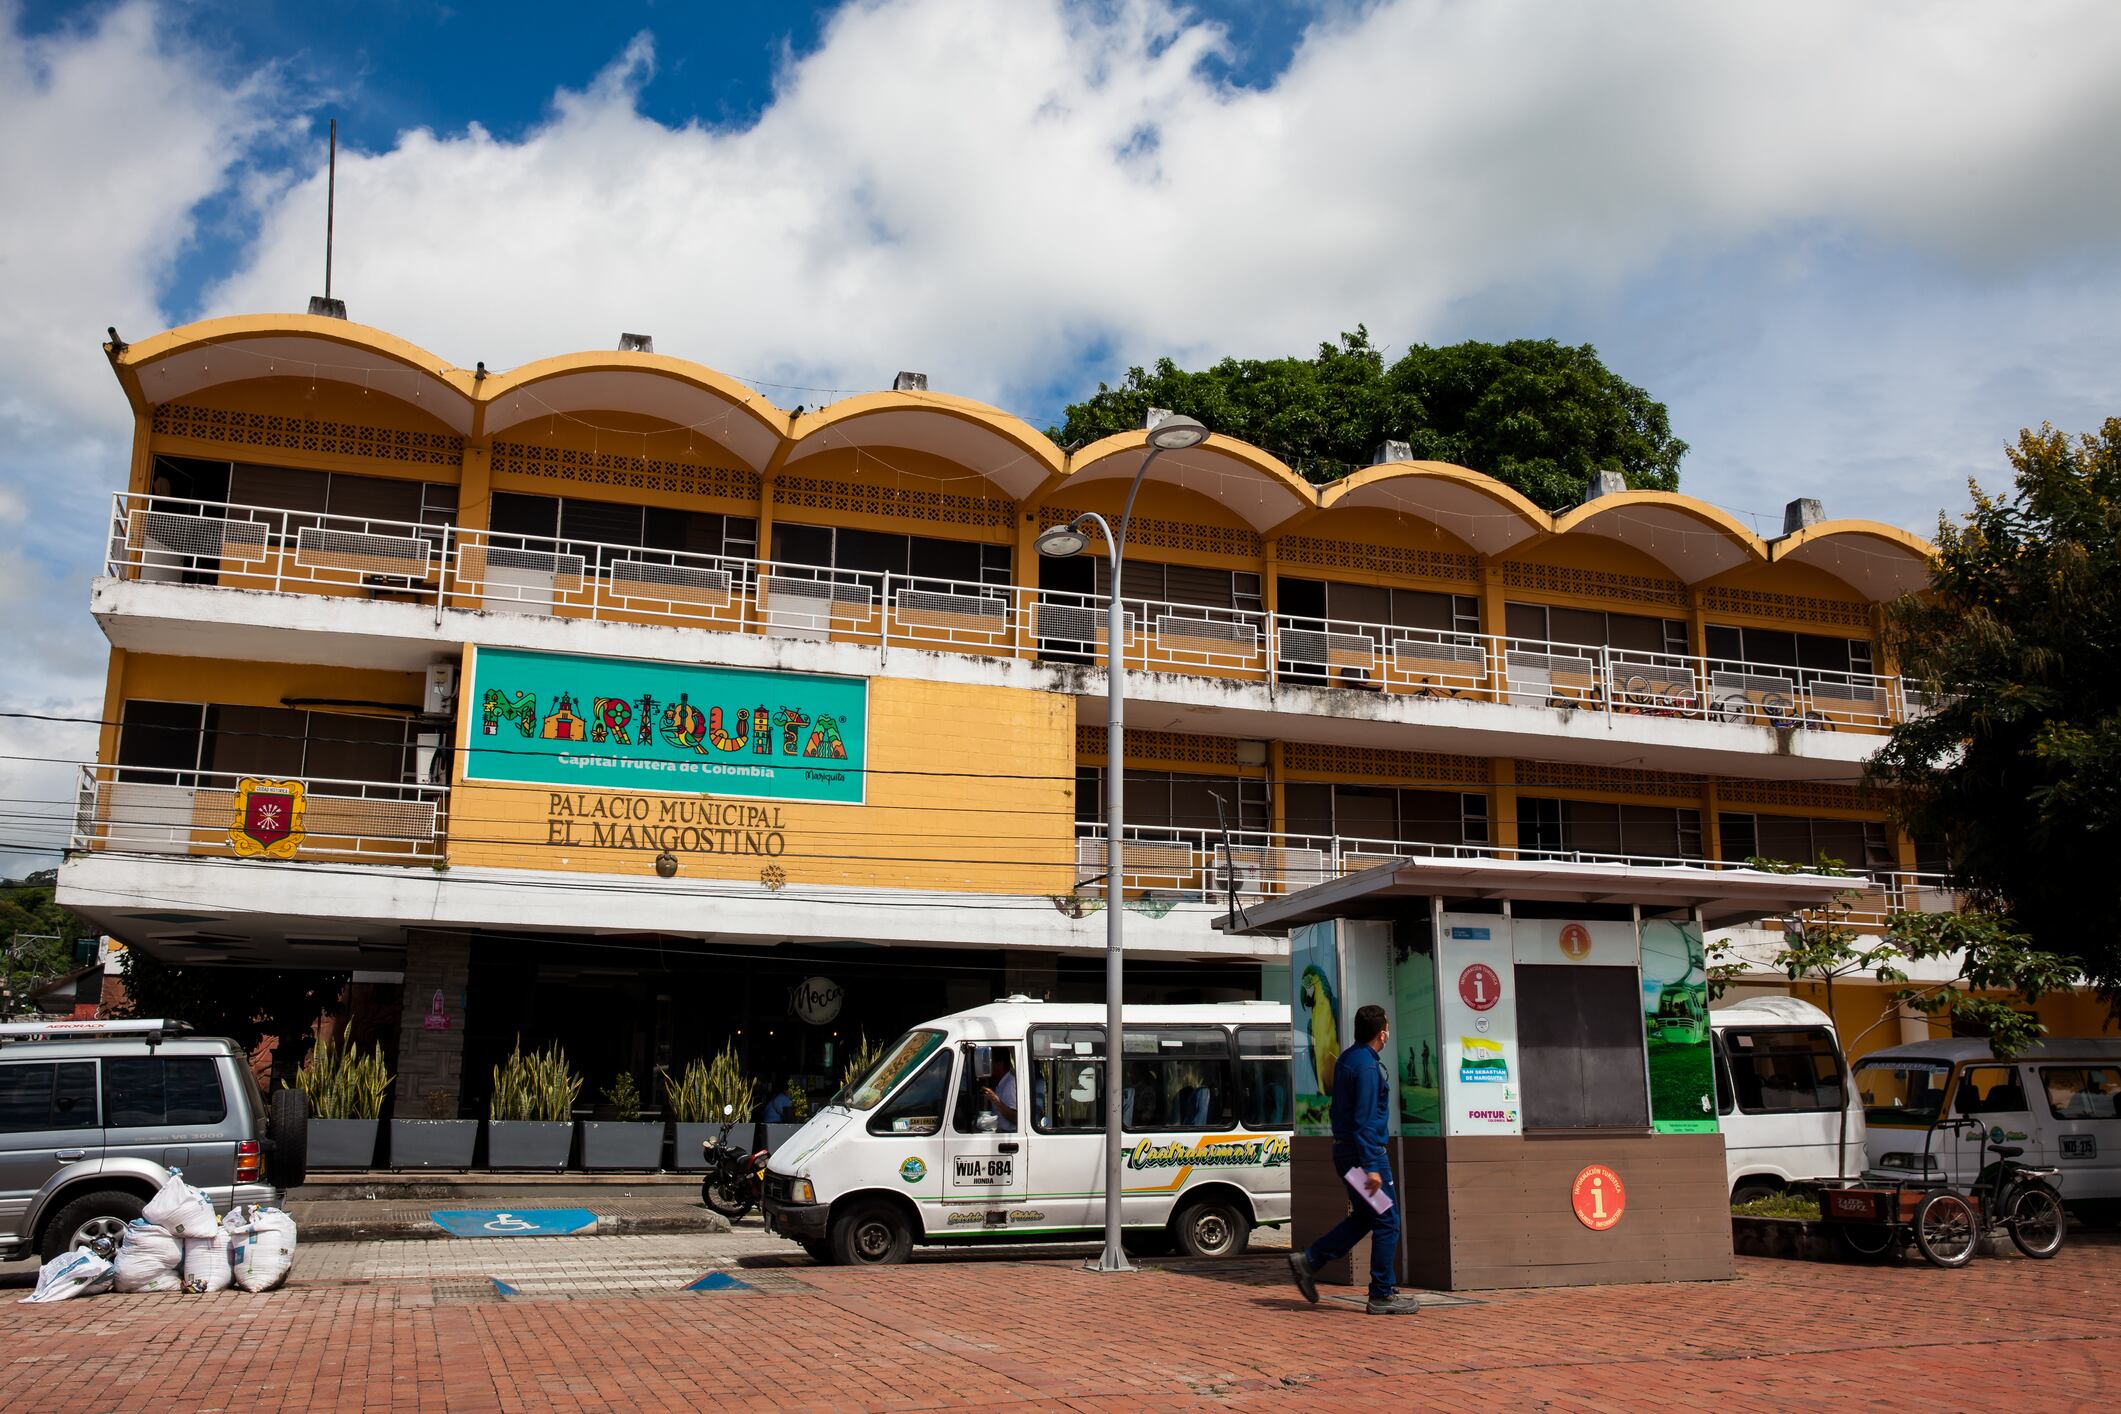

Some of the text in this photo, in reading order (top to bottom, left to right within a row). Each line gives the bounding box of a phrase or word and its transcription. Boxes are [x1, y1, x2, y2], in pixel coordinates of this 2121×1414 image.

[483, 689, 848, 760] MARIQUITA
[558, 751, 775, 779] Capital frutera de Colombia
[548, 793, 786, 829] PALACIO MUNICIPAL
[547, 819, 785, 858] EL MANGOSTINO
[788, 983, 844, 1015] Mocca
[988, 1161, 1011, 1176] 684
